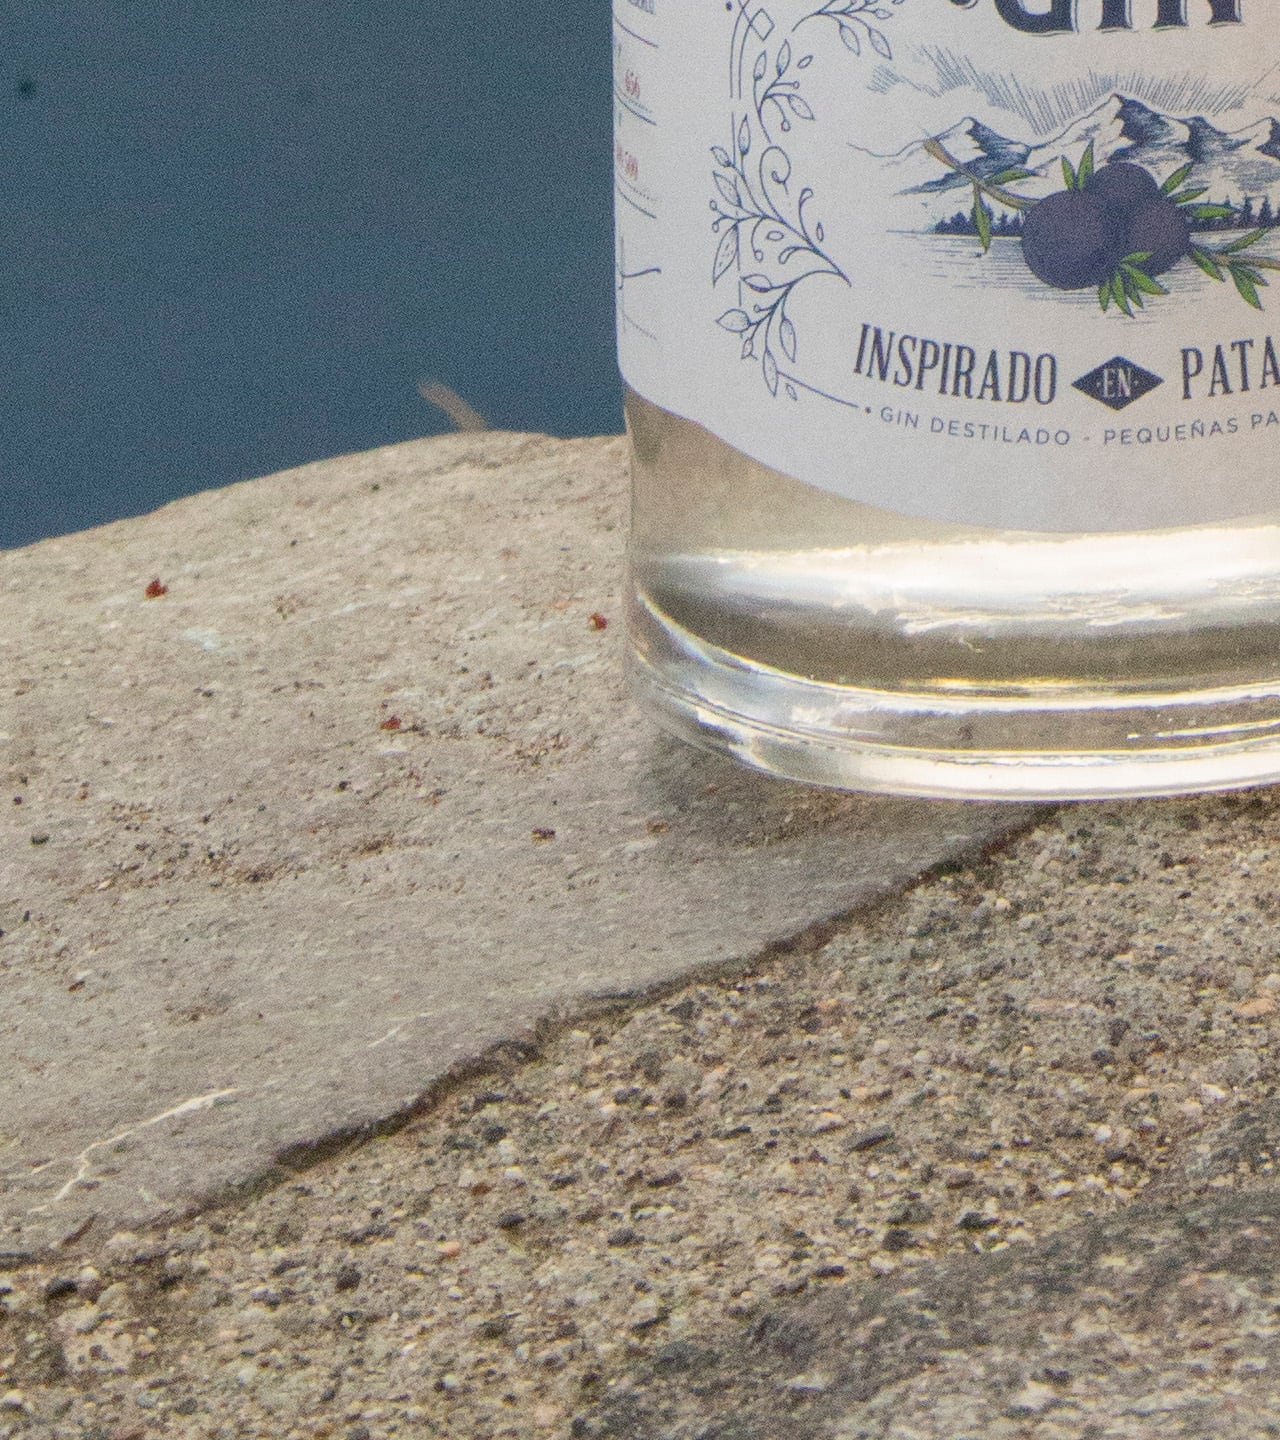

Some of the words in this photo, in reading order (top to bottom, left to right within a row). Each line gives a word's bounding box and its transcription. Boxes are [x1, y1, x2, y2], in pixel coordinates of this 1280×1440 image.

[853, 323, 1058, 406] INSPIRADO
[1101, 366, 1132, 399] EN
[880, 406, 920, 429] GIN
[930, 416, 1071, 446] DESTILADO
[1103, 418, 1239, 446] PEQUEÑAS
